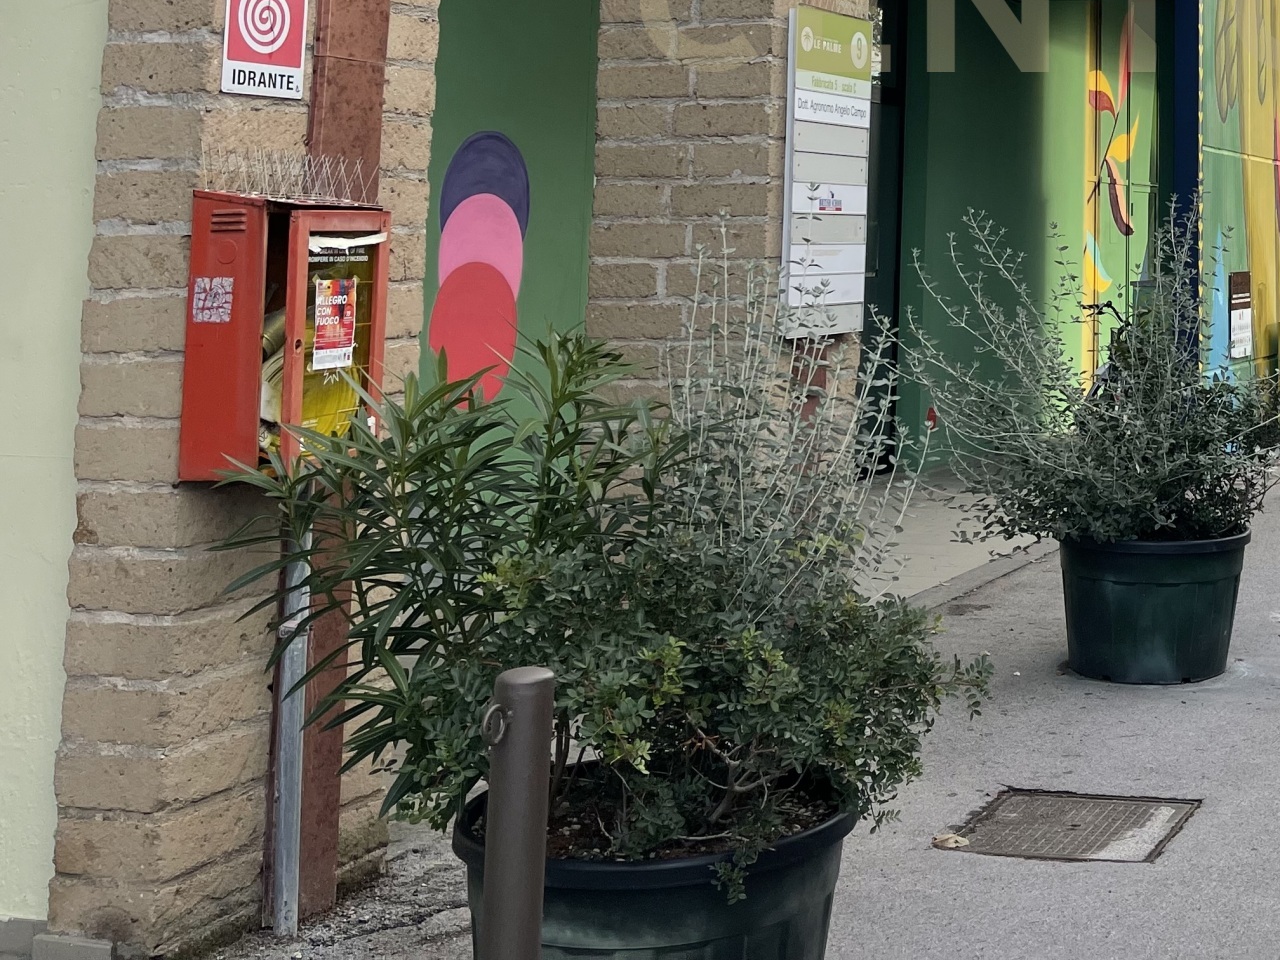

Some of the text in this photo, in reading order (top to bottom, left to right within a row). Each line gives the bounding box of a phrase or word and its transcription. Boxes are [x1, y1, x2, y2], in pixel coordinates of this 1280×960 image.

[814, 39, 842, 54] LE PALME
[856, 37, 862, 60] 9
[232, 68, 295, 91] IDRANTE
[797, 97, 867, 120] Dott. Agronomo Angelo Campo
[316, 294, 348, 306] ALLEGRO
[316, 306, 332, 316] CON
[316, 315, 340, 326] FUOCO
